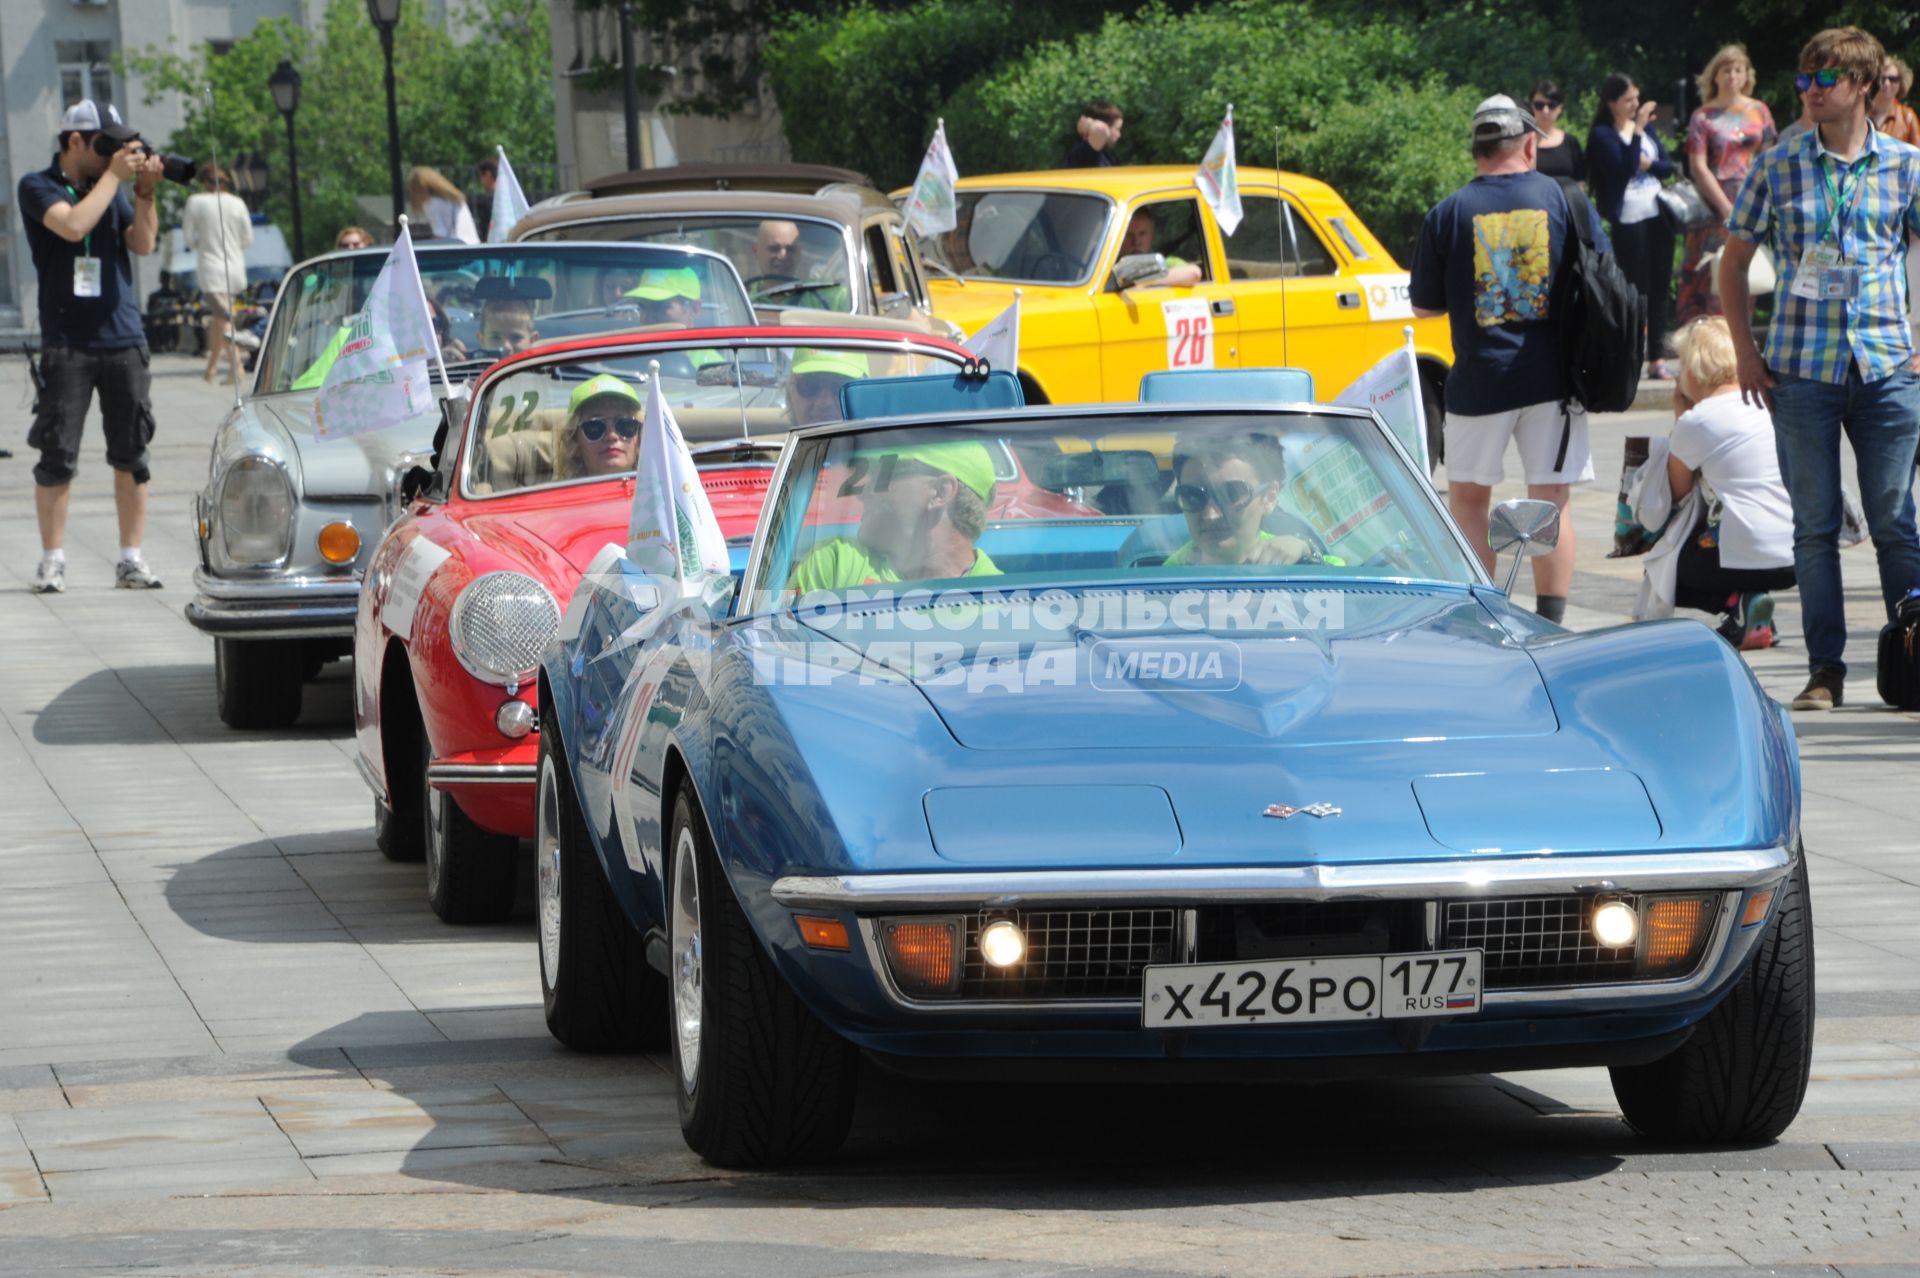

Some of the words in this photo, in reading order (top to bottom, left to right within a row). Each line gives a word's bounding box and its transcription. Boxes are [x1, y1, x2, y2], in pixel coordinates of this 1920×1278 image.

[1173, 317, 1207, 367] 26
[491, 390, 539, 439] 22
[837, 453, 898, 498] 21
[1390, 957, 1467, 997] 177
[1405, 996, 1444, 1010] RUS
